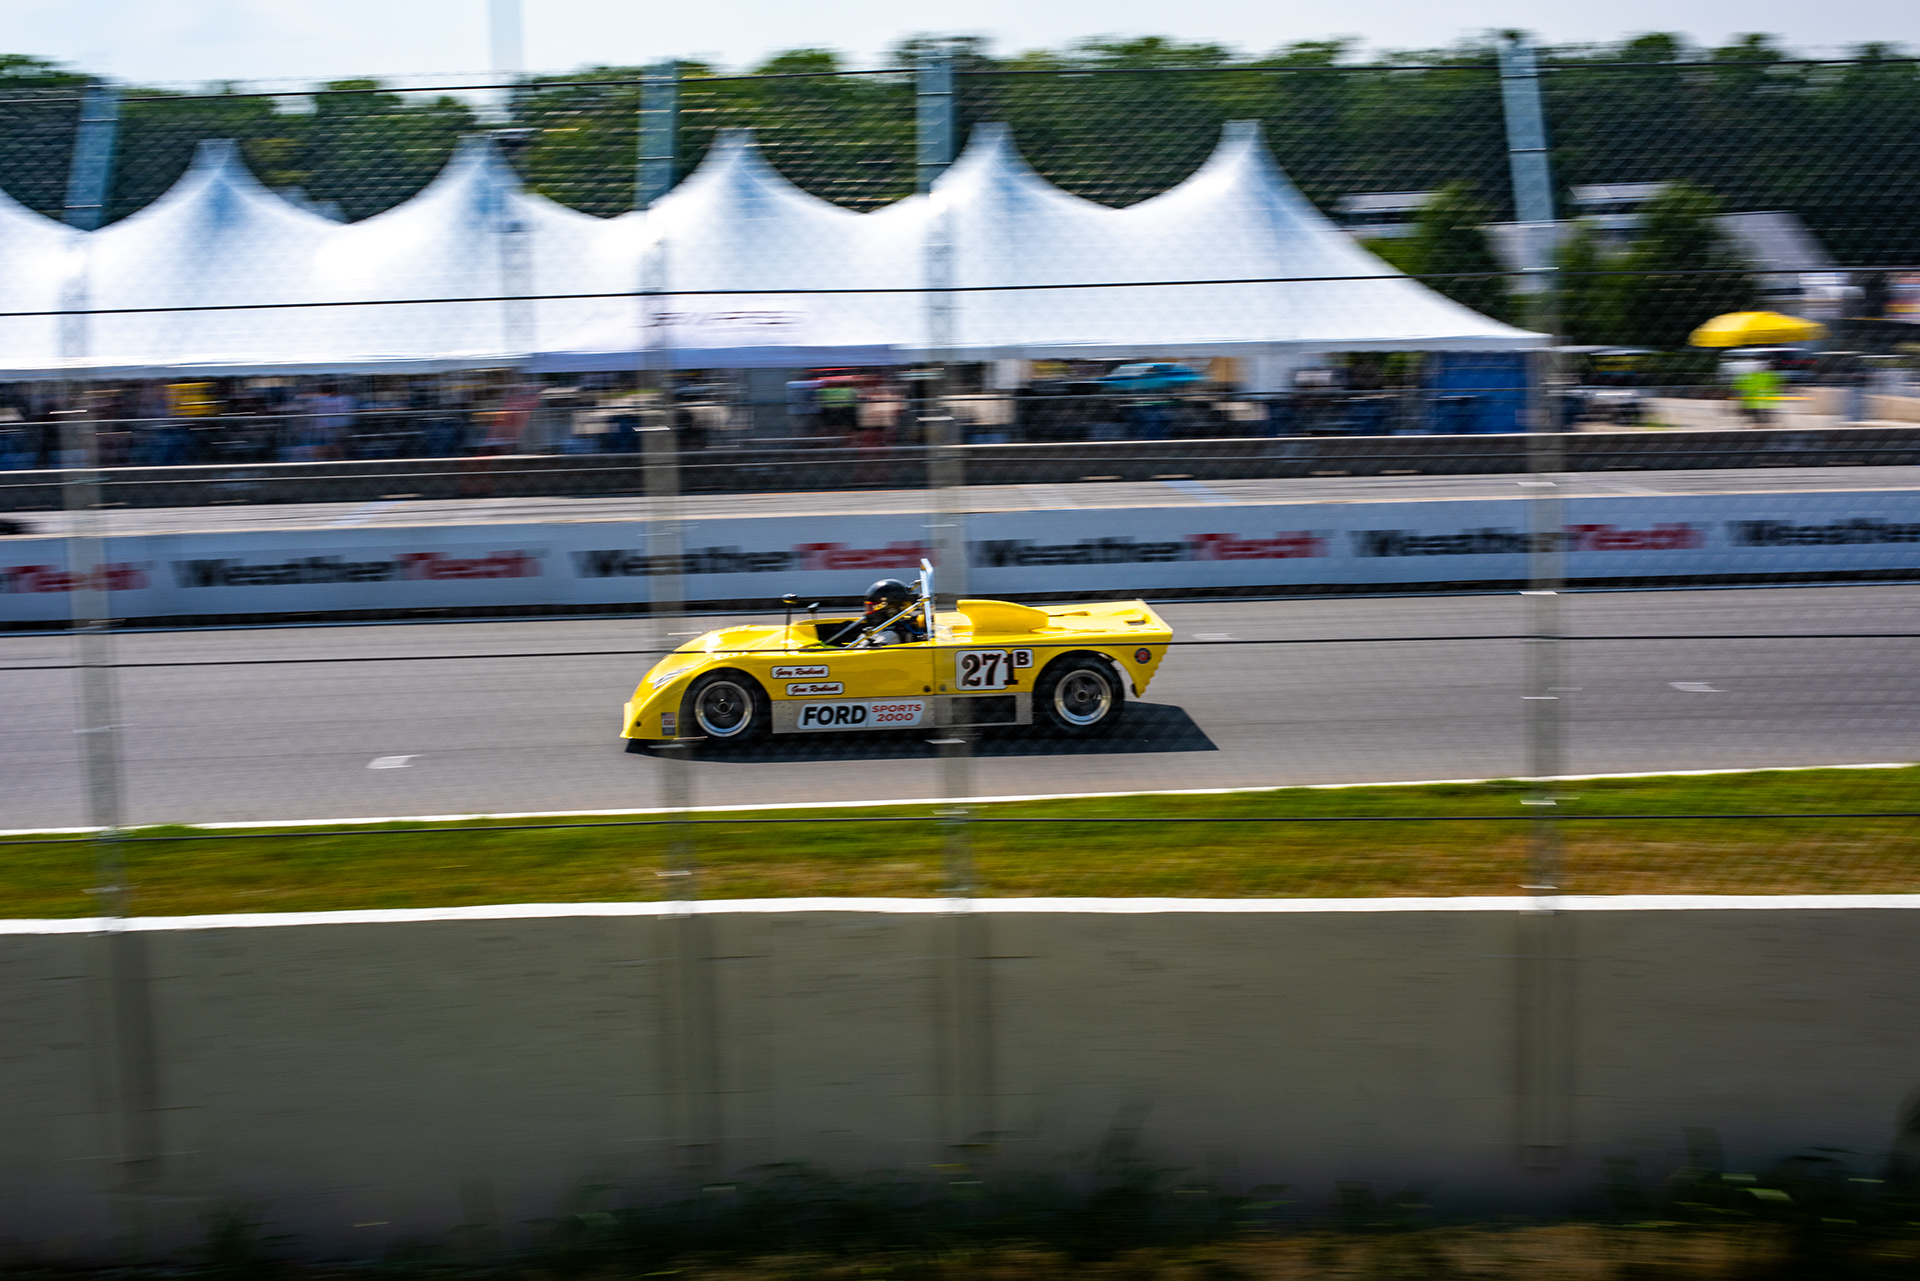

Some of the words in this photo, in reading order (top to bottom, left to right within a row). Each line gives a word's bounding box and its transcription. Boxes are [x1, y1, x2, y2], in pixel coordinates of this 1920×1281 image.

[968, 531, 1330, 567] WeatherTech
[173, 549, 543, 588] WeatherTech
[961, 653, 1018, 686] 271
[1016, 652, 1029, 665] B
[803, 705, 866, 725] FORD
[872, 704, 922, 713] SPORTS
[876, 713, 914, 722] 2000
